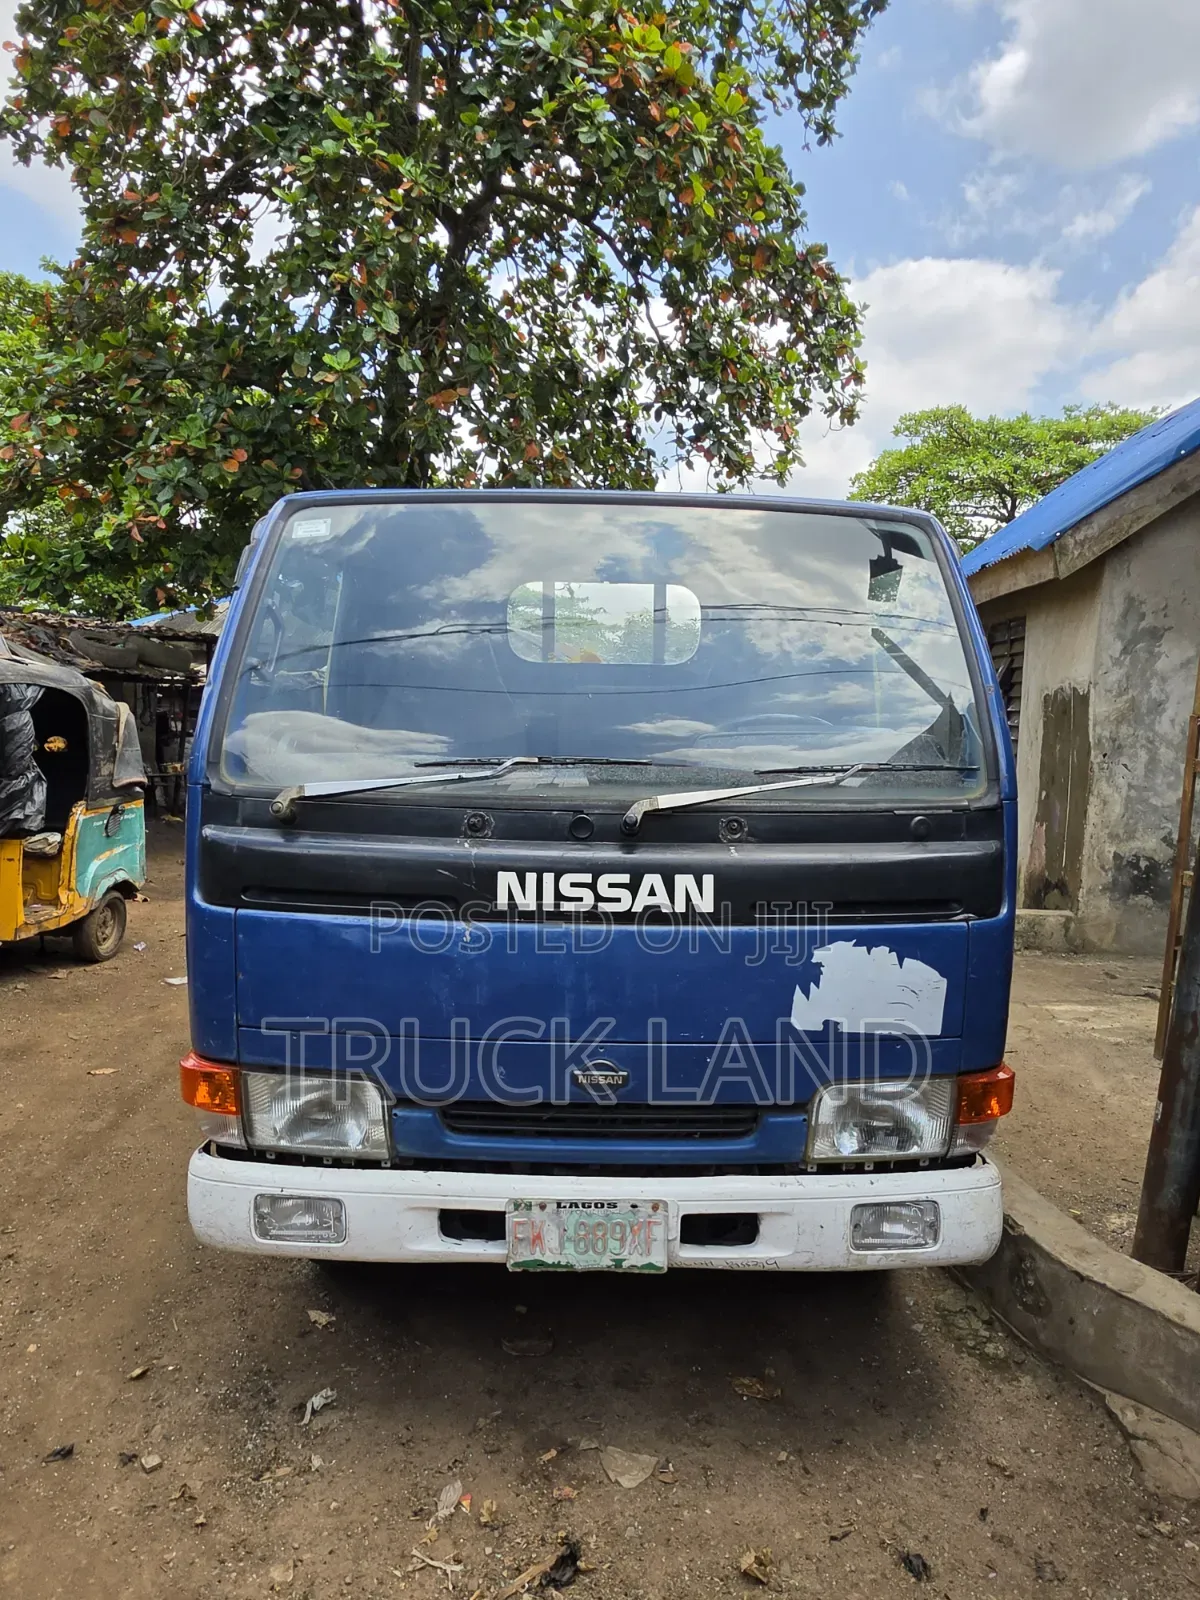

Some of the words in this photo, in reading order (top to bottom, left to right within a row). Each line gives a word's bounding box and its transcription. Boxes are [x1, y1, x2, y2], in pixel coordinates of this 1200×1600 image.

[496, 871, 714, 913] NISSAN
[578, 1074, 623, 1085] NISSAN
[556, 1201, 618, 1209] LAGOS
